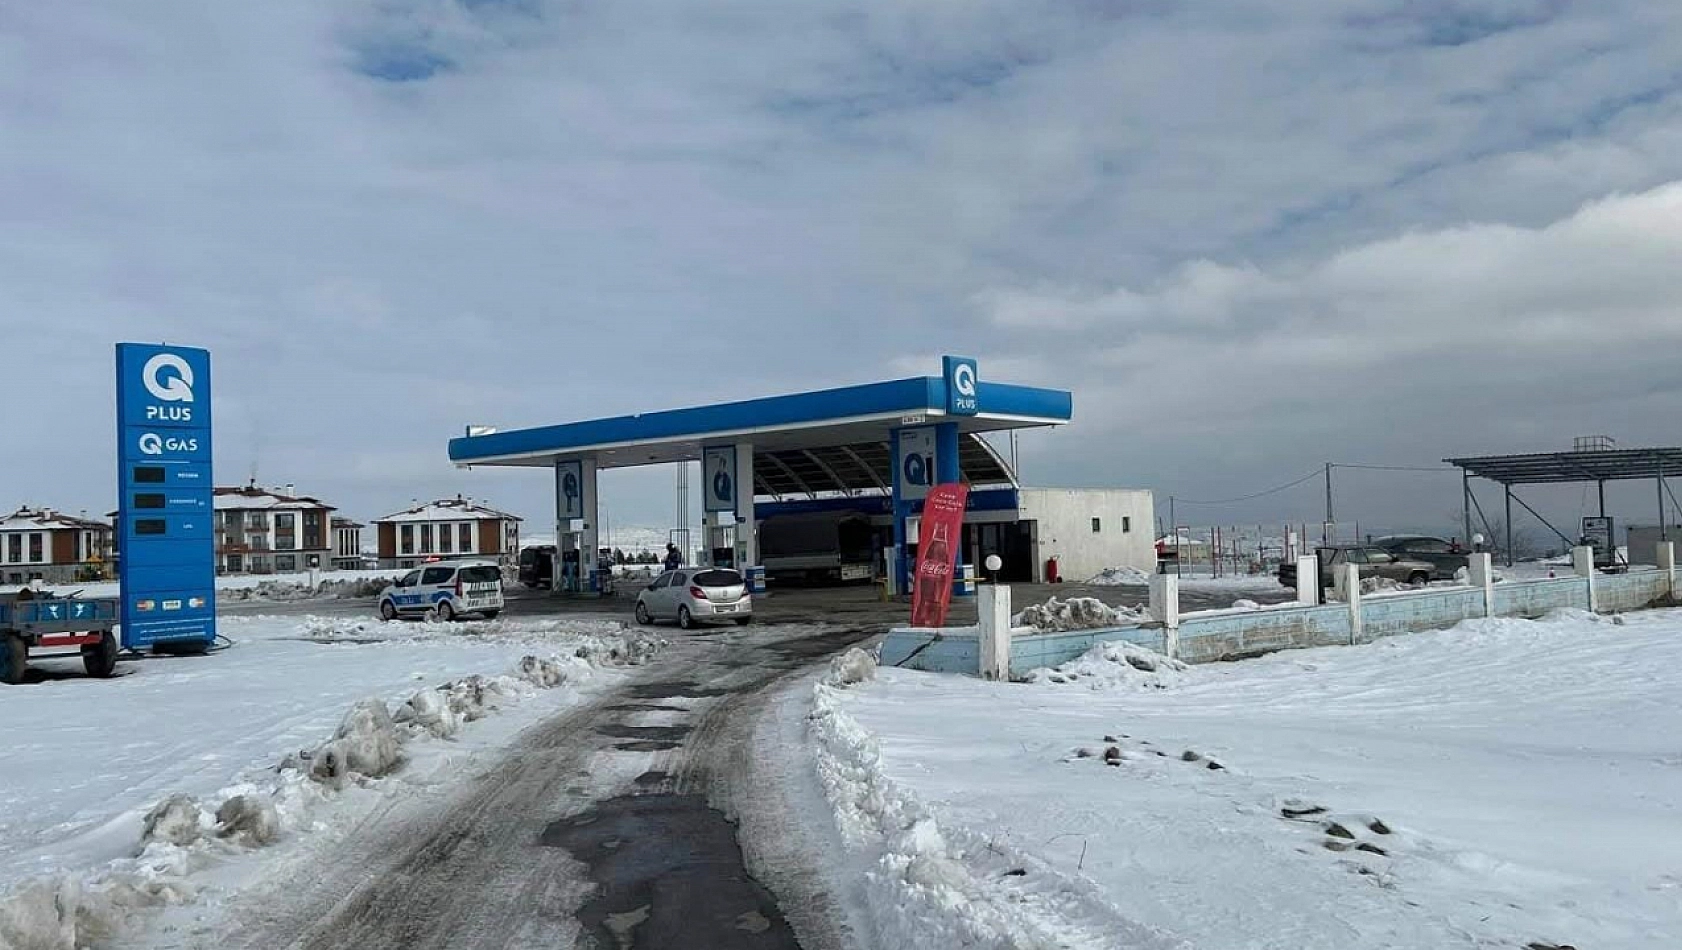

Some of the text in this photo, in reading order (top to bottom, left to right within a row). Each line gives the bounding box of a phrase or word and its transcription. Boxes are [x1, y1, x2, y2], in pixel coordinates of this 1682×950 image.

[143, 353, 194, 403] Q
[954, 363, 975, 396] Q
[955, 397, 976, 410] PLUS
[146, 406, 191, 421] PLUS
[139, 433, 198, 455] Q GAS
[920, 560, 950, 575] Coca-Cola
